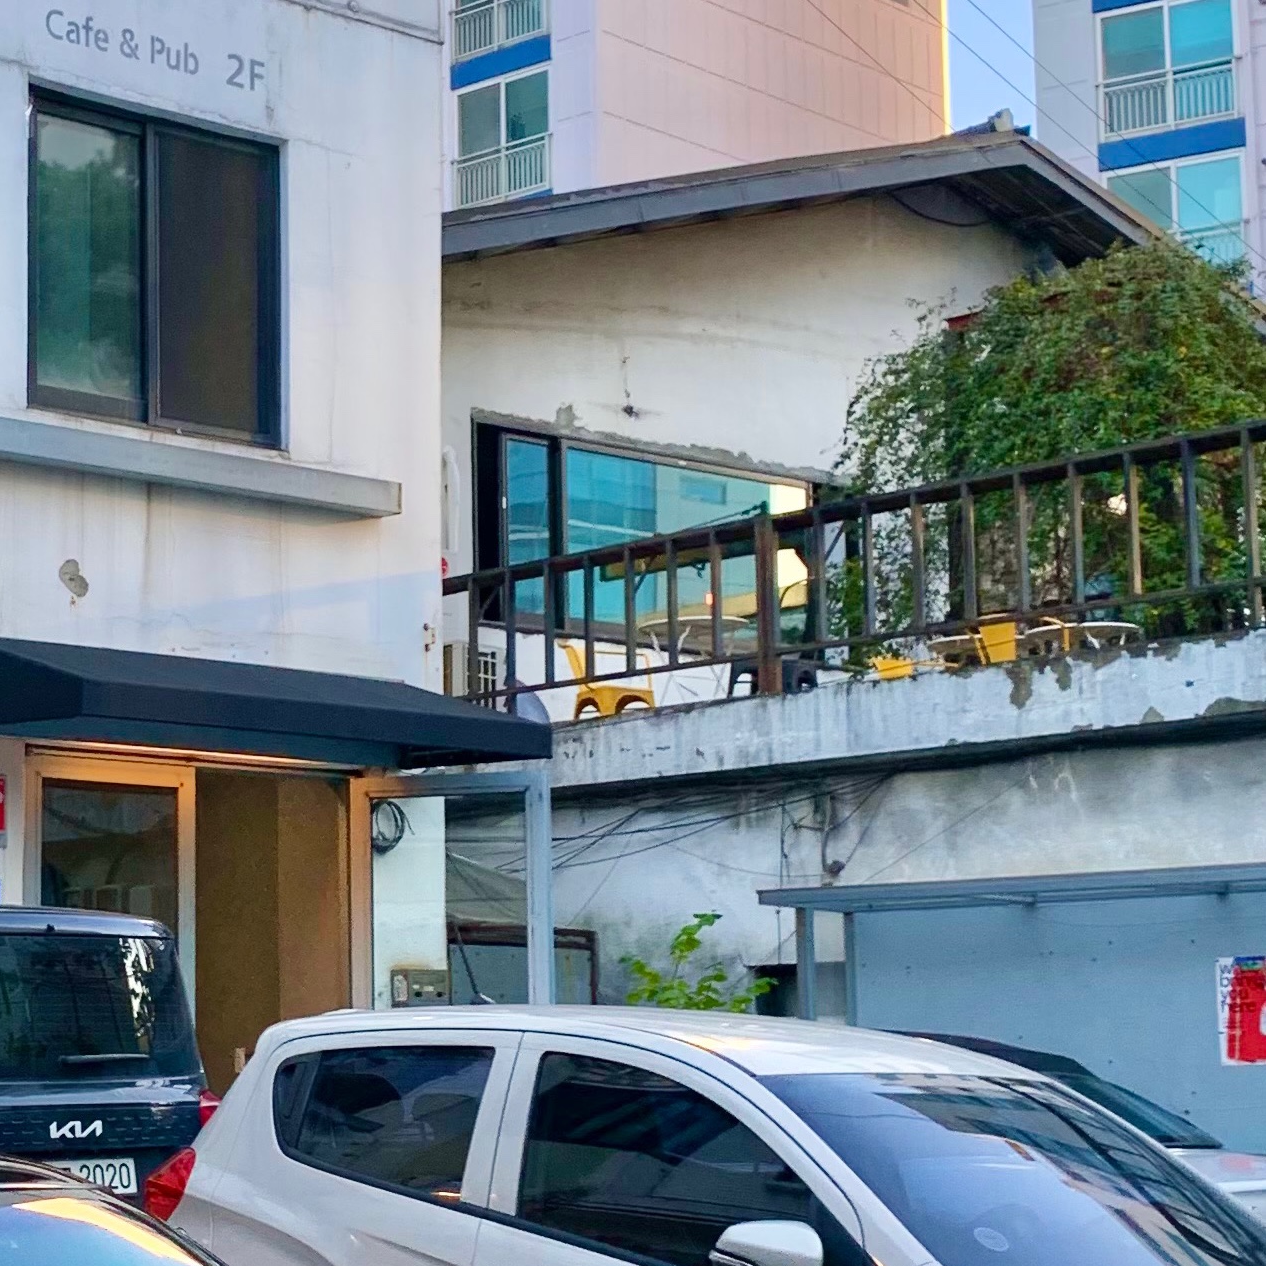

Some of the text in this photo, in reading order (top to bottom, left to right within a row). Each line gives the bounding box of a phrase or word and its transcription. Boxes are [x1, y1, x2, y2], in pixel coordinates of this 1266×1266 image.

[46, 9, 265, 91] Cafe & Pub 2F
[49, 1120, 103, 1138] KIA
